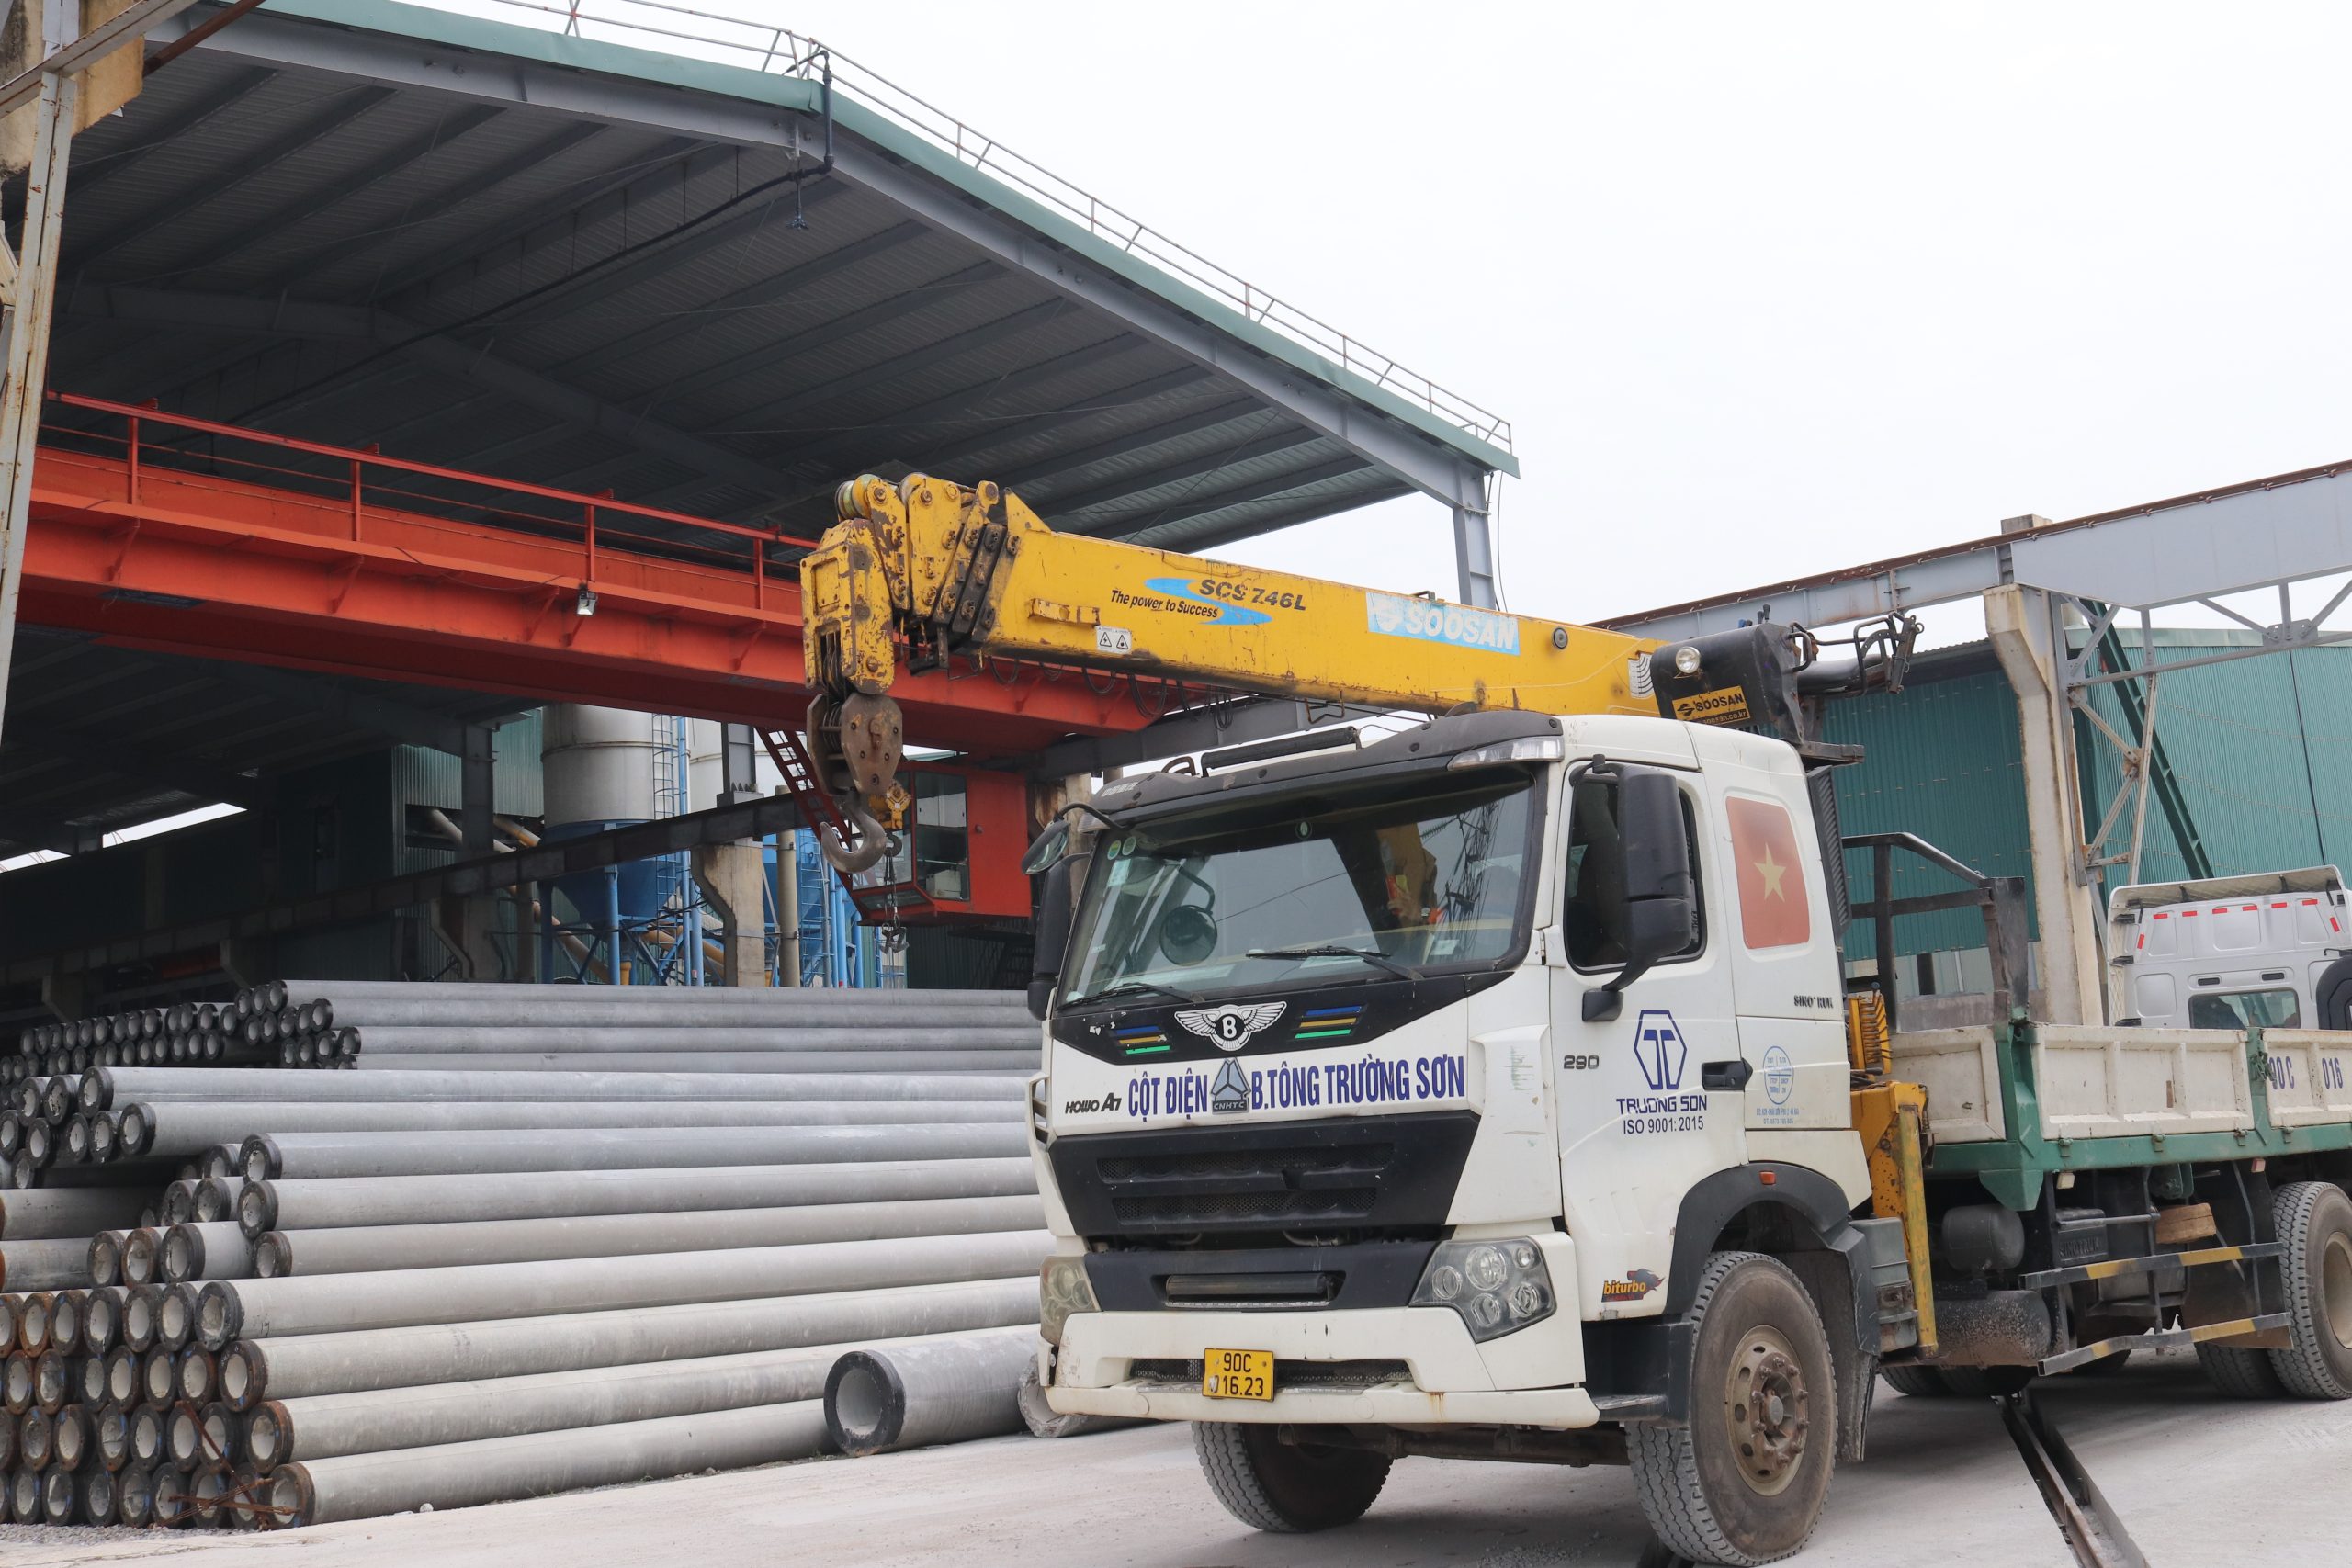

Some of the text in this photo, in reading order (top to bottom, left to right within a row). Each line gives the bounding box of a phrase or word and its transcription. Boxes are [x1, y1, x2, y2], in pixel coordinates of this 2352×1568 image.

[1111, 589, 1218, 618] The power to Success
[1199, 579, 1306, 611] SCS 746L
[1406, 604, 1516, 649] SOOSAN
[1695, 693, 1744, 712] SOOSAN
[1563, 1055, 1600, 1070] 290
[2322, 1057, 2344, 1089] 016
[1128, 1054, 1465, 1122] CỘT ĐIỆN B.TÔNG TRƯỜNG SƠN
[1065, 1092, 1123, 1114] HOWO A7
[1213, 1101, 1245, 1110] CNHTC
[1680, 1095, 1707, 1112] SON
[1623, 1119, 1645, 1134] ISO
[1603, 1280, 1646, 1295] biturbo
[1223, 1352, 1252, 1373] 90C
